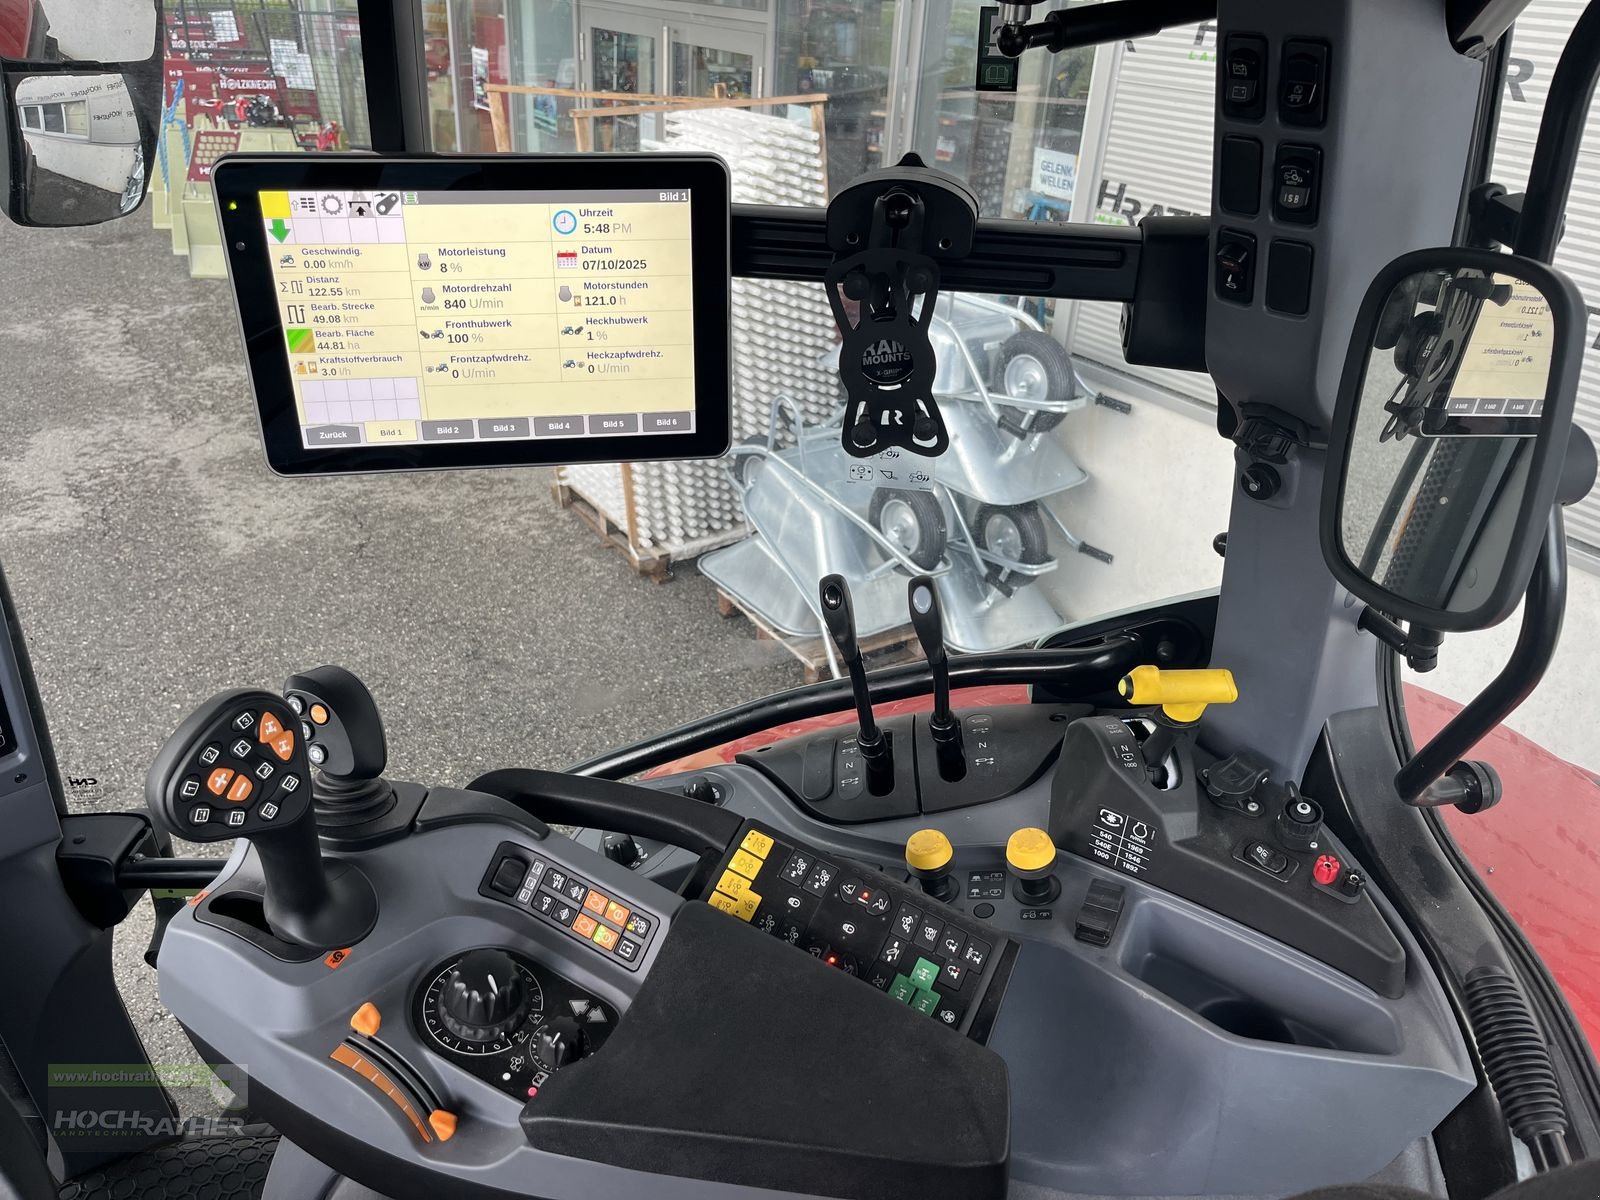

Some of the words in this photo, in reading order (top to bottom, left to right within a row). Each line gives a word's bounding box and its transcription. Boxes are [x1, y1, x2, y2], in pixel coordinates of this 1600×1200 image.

[1040, 160, 1073, 177] GELENK
[1040, 174, 1073, 192] WELLEN
[659, 192, 679, 201] Bild
[681, 192, 688, 201] 1
[579, 208, 613, 217] Uhrzeit
[583, 223, 610, 234] 5:48
[612, 223, 632, 233] PM
[301, 248, 363, 257] Geschwindig.
[438, 248, 506, 257] Motorleistung
[581, 246, 612, 254] Datum
[303, 260, 326, 269] 0.00
[328, 260, 353, 268] km/h
[440, 263, 448, 273] 8
[450, 263, 463, 273] %
[582, 259, 647, 271] 07/10/2025
[306, 276, 339, 284] Distanz
[442, 284, 512, 293] Motordrehzahl
[583, 281, 648, 290] Motorstunden
[309, 288, 343, 296] 122.55
[346, 287, 360, 296] km
[444, 299, 466, 309] 840
[469, 298, 504, 309] U/min
[585, 295, 617, 306] 121.0
[619, 295, 626, 305] h
[310, 303, 340, 311] Bearb.
[342, 302, 375, 310] Strecke
[312, 315, 341, 324] 49.08
[343, 315, 359, 323] km
[445, 319, 512, 329] Fronthubwerk
[585, 316, 648, 325] Heckhubwerk
[315, 330, 344, 338] Bearb.
[346, 329, 375, 337] Fläche
[586, 331, 594, 341] 1
[596, 330, 608, 341] %
[447, 333, 469, 344] 100
[471, 333, 484, 343] %
[317, 341, 345, 350] 44.81
[347, 340, 360, 350] ha
[319, 354, 403, 364] Kraftstoffverbrauch
[450, 354, 532, 364] Frontzapfwdrehz.
[586, 350, 664, 360] Heckzapfwdrehz.
[862, 351, 911, 366] MOUNTS
[321, 368, 337, 377] 3.0
[588, 364, 595, 374] 0
[597, 363, 630, 374] U/min
[452, 369, 459, 379] 0
[461, 368, 496, 378] U/min
[548, 422, 564, 430] Bild
[603, 420, 618, 428] Bild
[619, 420, 624, 428] 5
[656, 418, 671, 426] Bild
[672, 418, 677, 426] 6
[437, 427, 452, 435] Bild
[493, 424, 509, 432] Bild
[510, 424, 515, 432] 3
[319, 431, 348, 439] Zurück
[380, 429, 396, 437] Bild
[242, 717, 250, 725] 3
[206, 751, 215, 759] 2
[1099, 831, 1113, 840] 540
[1095, 839, 1112, 851] 540E
[1093, 849, 1110, 860] 1000
